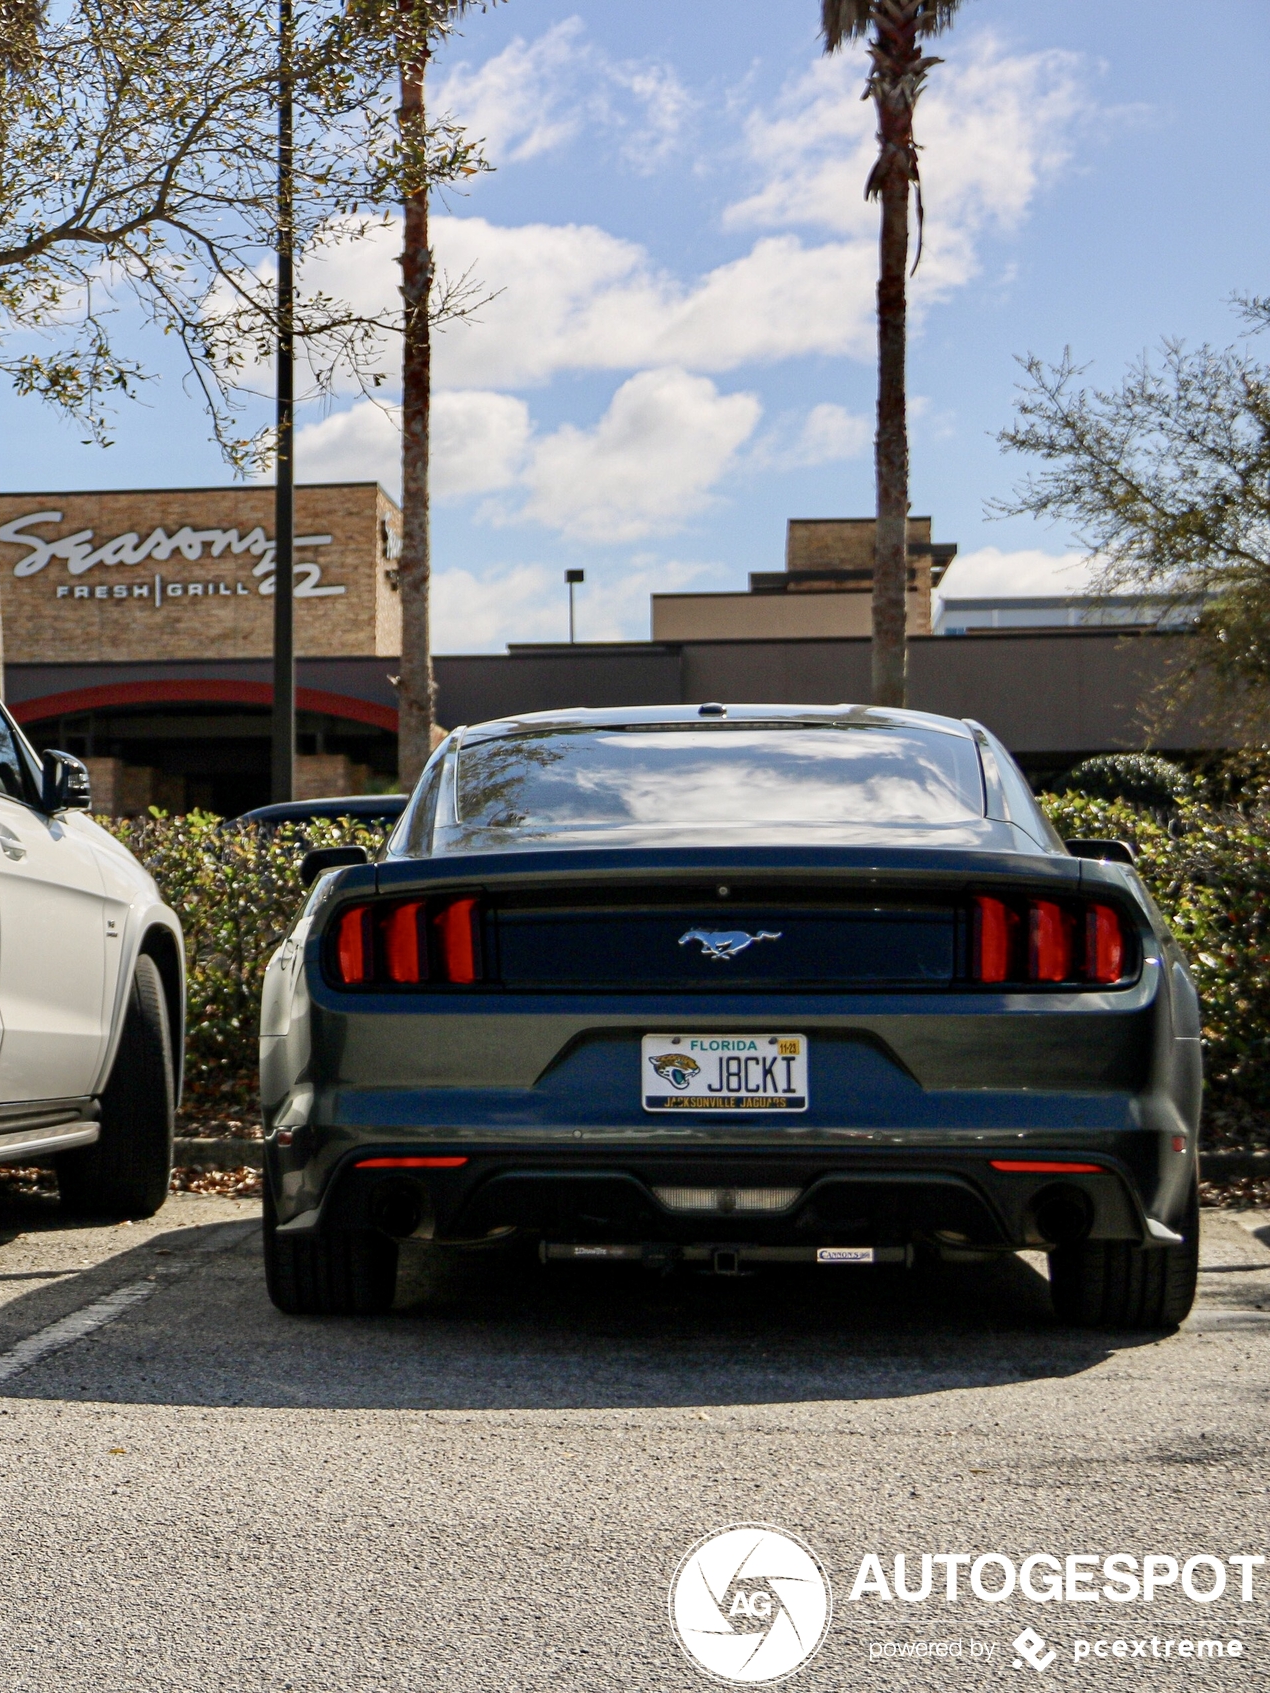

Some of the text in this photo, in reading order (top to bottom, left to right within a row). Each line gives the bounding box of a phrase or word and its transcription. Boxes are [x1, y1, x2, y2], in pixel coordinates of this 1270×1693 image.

[0, 511, 267, 577] Seasons
[57, 582, 249, 598] FRESH GRILL
[690, 1040, 758, 1051] FLORIDA
[707, 1057, 796, 1093] J8CKI
[664, 1096, 787, 1108] JACKSONVILLE JAGUARS
